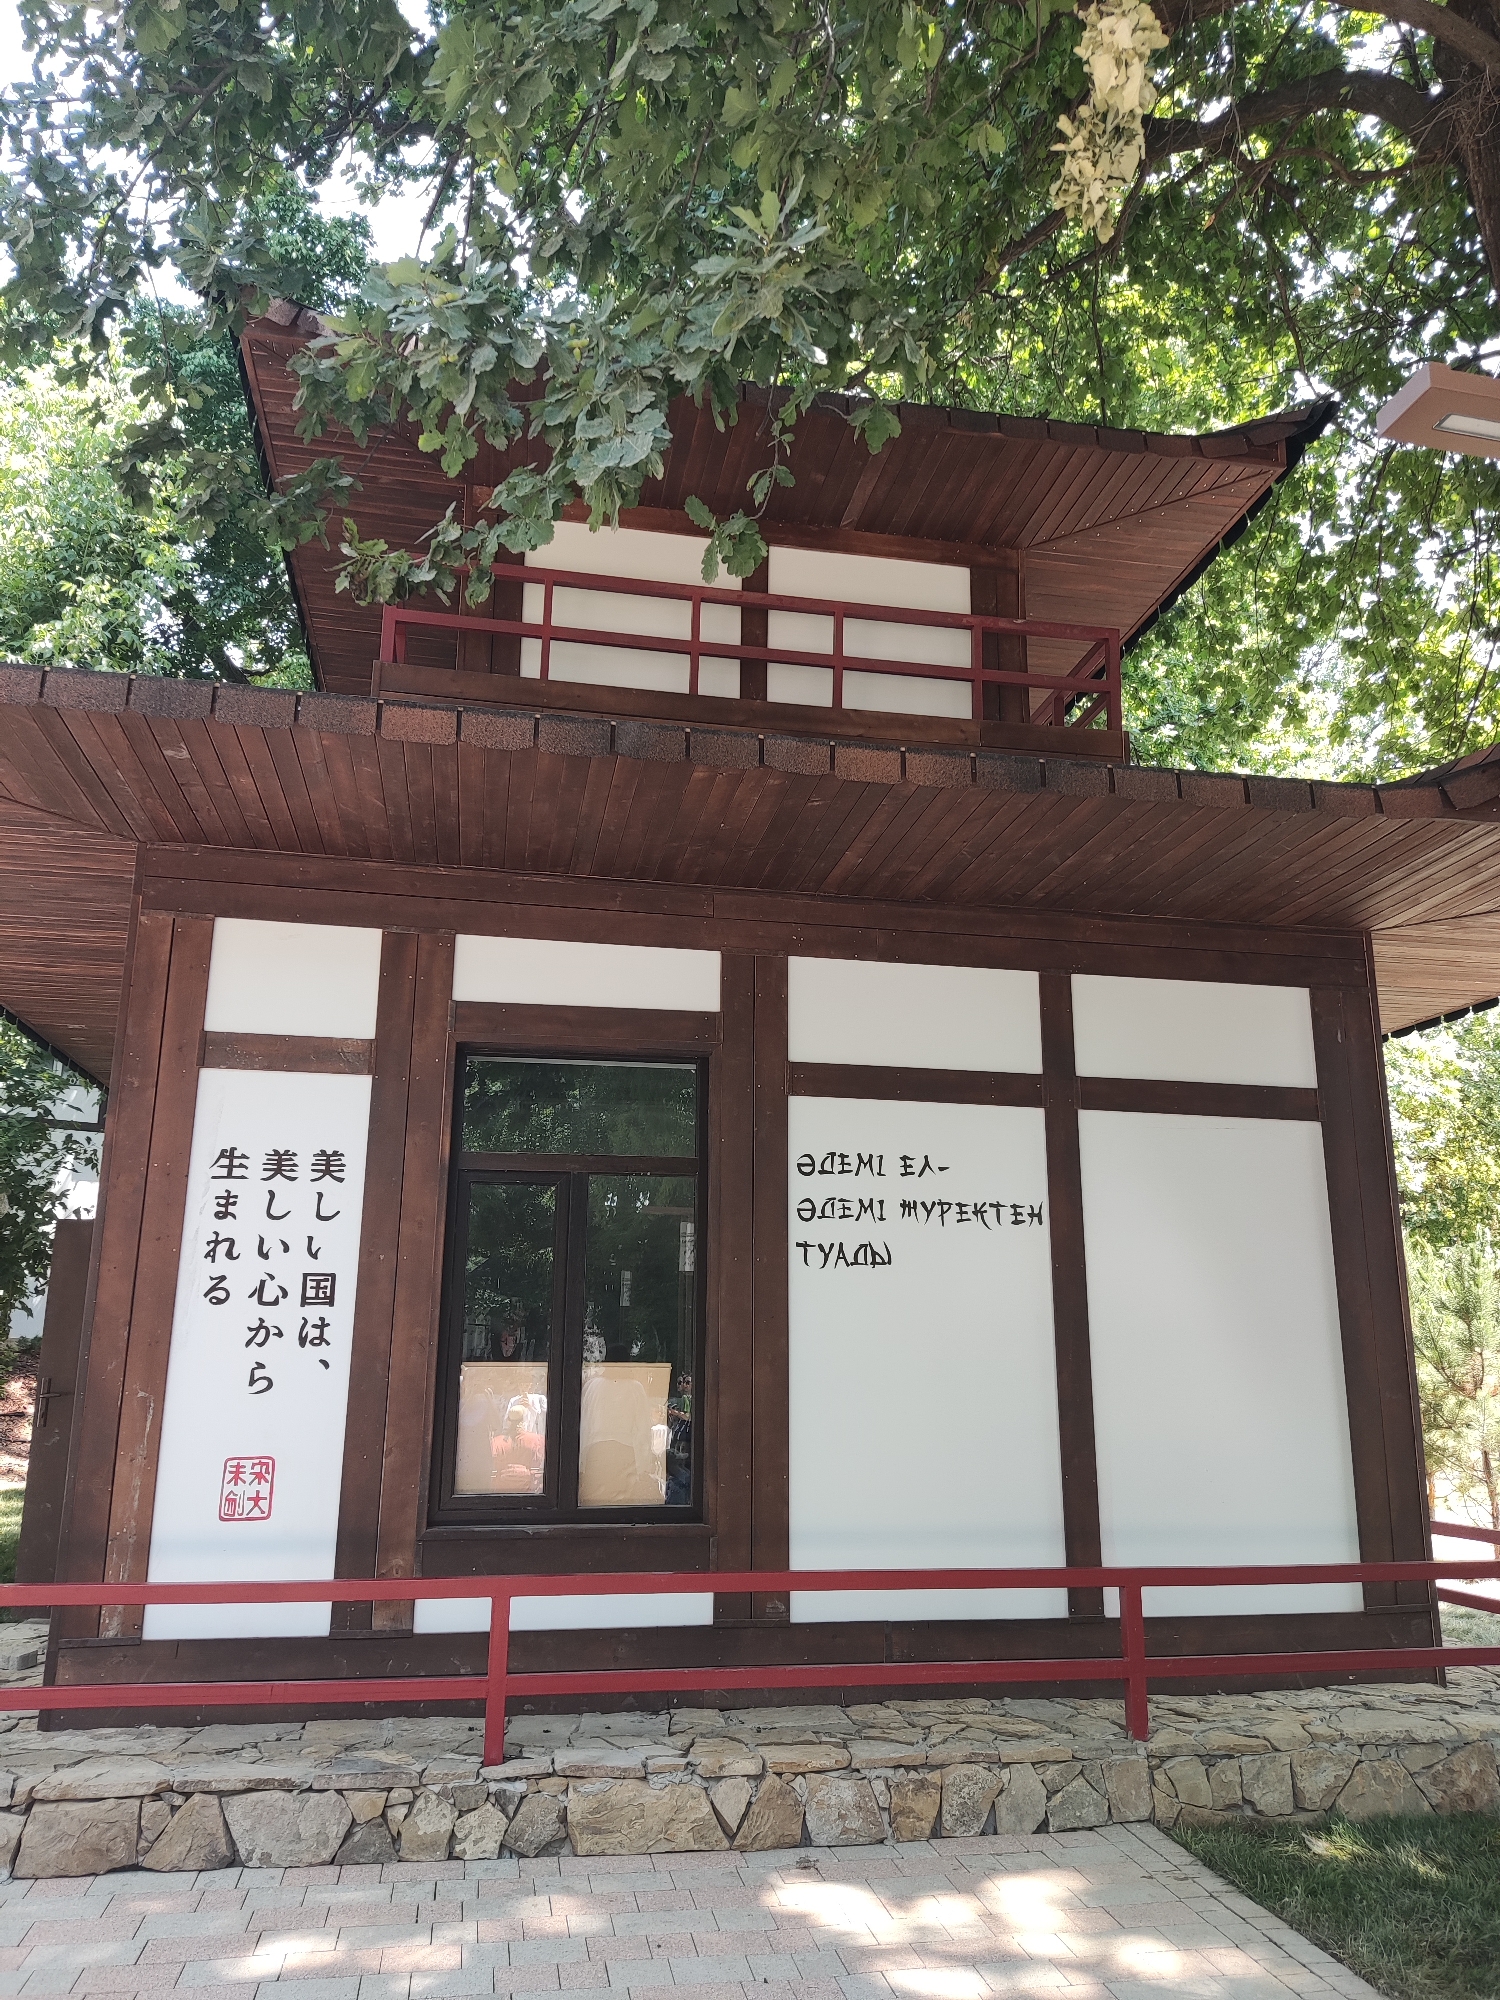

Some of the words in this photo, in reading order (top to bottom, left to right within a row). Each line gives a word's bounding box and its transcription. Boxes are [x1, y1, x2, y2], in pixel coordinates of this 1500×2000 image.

[796, 1152, 887, 1177] ӘДЕМІ
[796, 1196, 887, 1223] ӘДЕМІ
[202, 1146, 251, 1307] 生まれる
[795, 1240, 892, 1270] ТУАДЫ
[244, 1148, 300, 1396] 美しい心から
